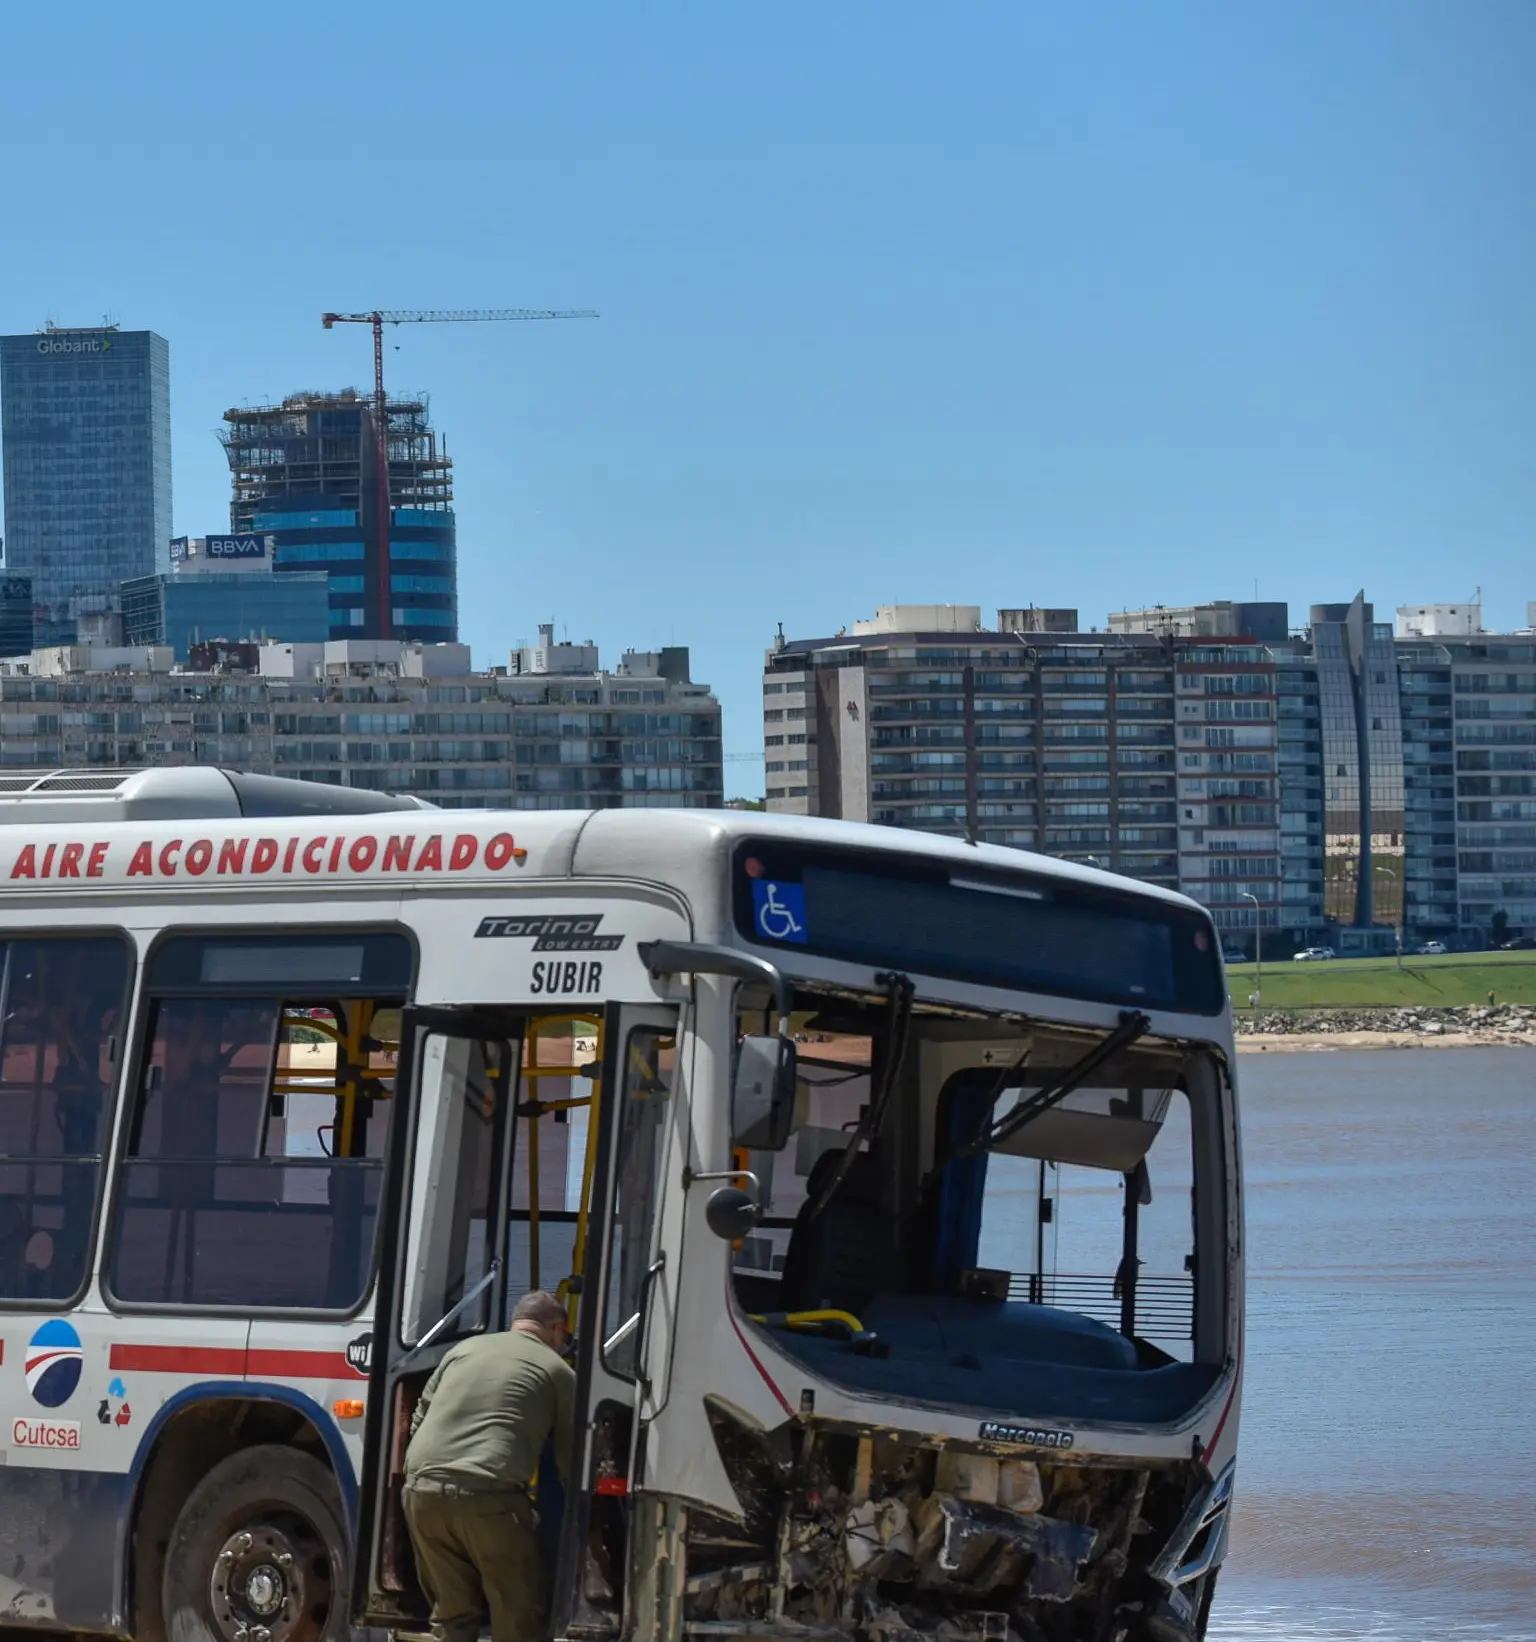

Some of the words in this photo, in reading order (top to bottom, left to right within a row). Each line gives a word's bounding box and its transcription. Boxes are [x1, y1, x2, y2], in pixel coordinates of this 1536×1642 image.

[37, 339, 100, 354] Globant
[211, 539, 259, 554] BBVA
[9, 841, 111, 879] AIRE
[126, 832, 515, 876] ACONDICIONADO
[484, 918, 594, 936] Torino
[537, 941, 568, 950] LOW
[571, 939, 620, 949] ENTRY
[530, 961, 602, 994] SUBIR
[14, 1420, 78, 1447] Cutcsa
[983, 1423, 1073, 1448] Marcopolo
